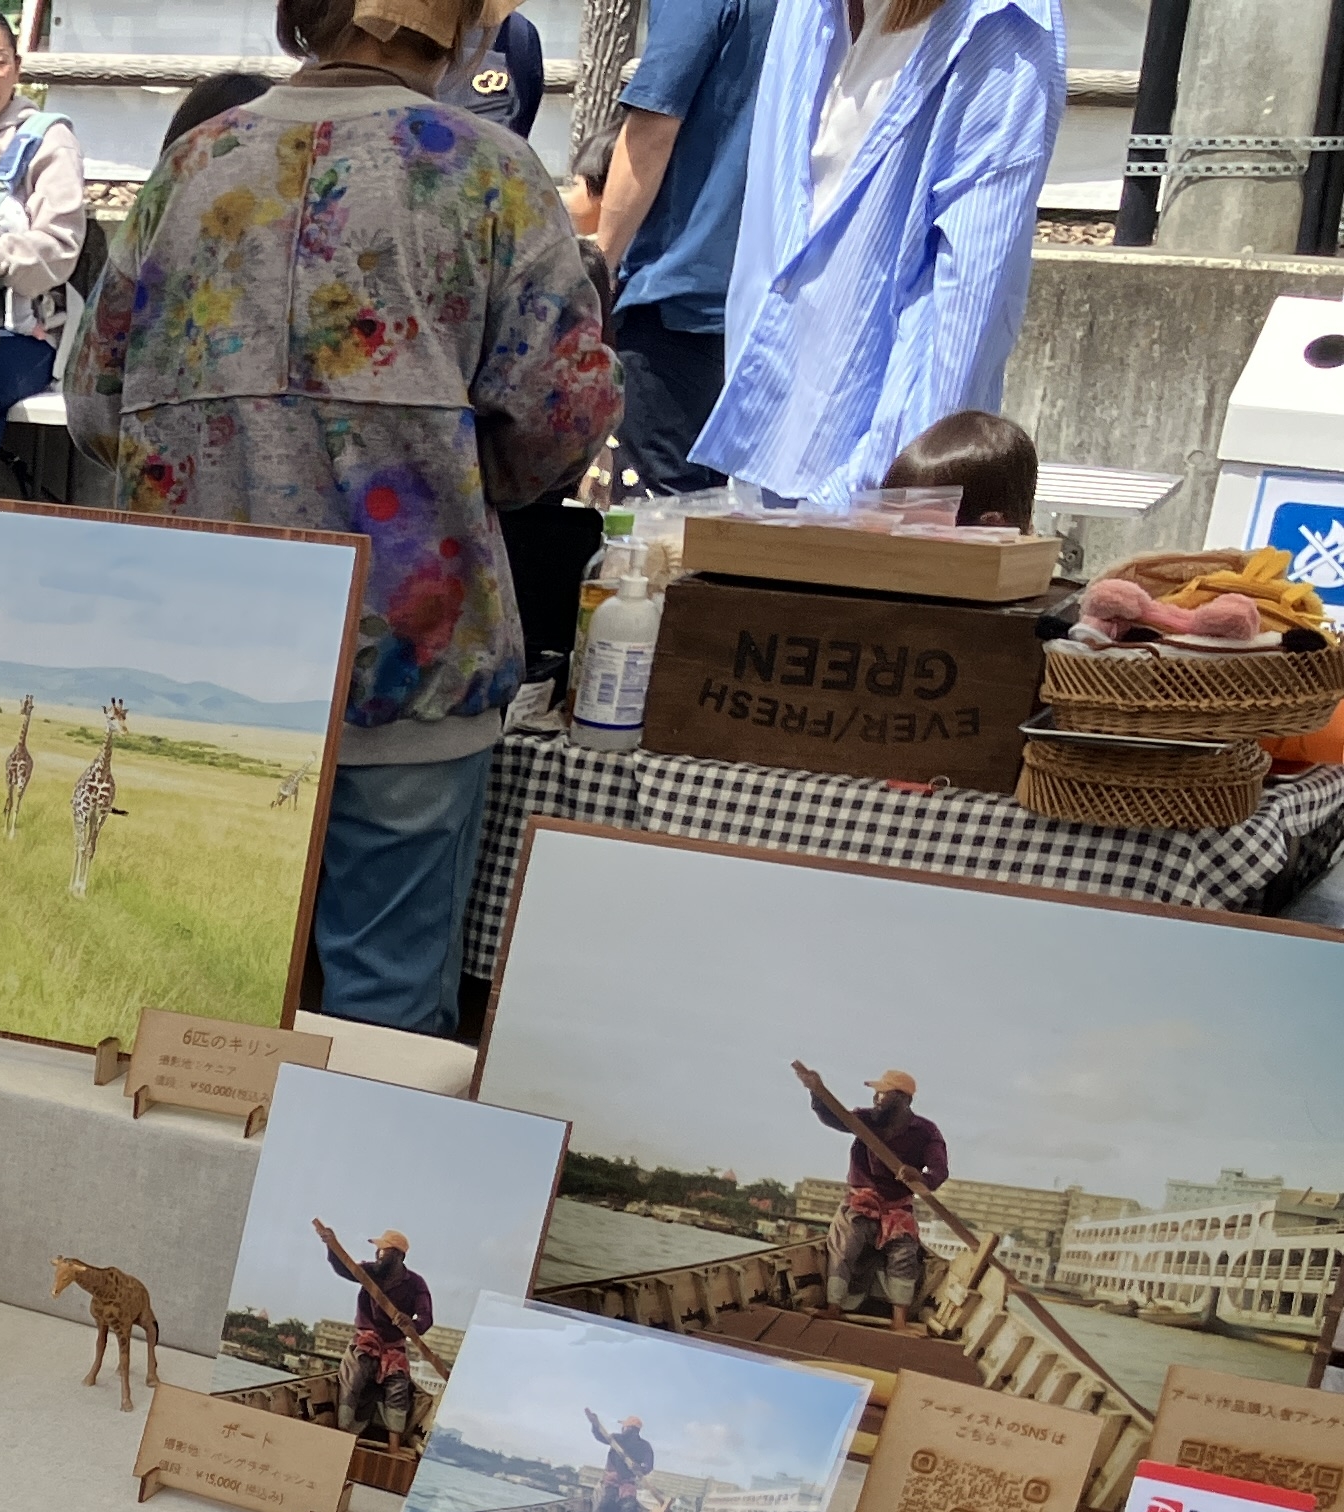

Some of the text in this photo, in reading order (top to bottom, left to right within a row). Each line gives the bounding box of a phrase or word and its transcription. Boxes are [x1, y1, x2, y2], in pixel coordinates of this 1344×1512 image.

[733, 629, 958, 700] GREEN
[696, 677, 981, 745] EVER/FRESH
[182, 1027, 280, 1058] 6匹のキリン
